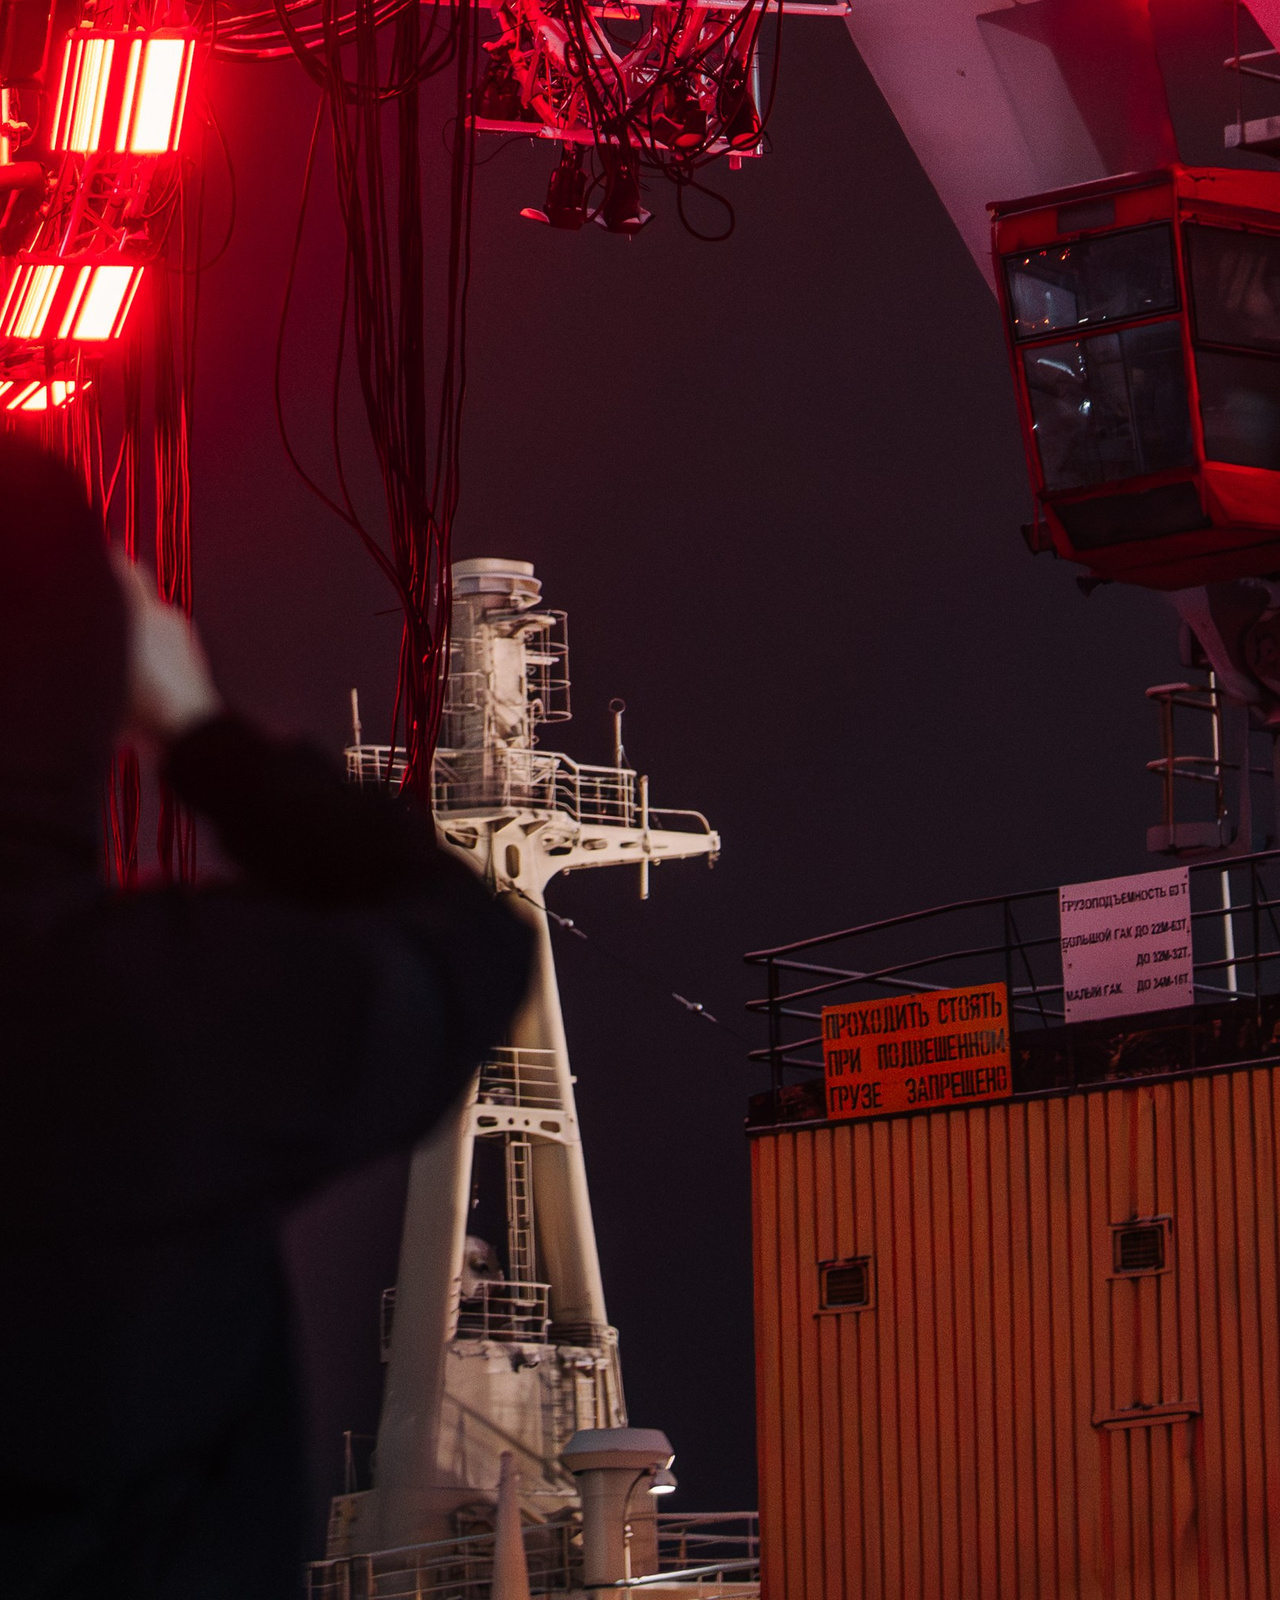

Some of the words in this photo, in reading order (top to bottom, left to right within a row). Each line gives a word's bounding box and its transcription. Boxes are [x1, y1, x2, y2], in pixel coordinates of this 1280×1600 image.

[1062, 888, 1166, 912] ГРУЗОПОДЪЕМНОСТЬ
[1061, 928, 1112, 949] БОЛЬШОЙ
[1114, 926, 1132, 939] ГАК
[1135, 923, 1149, 939] ДО
[1136, 953, 1150, 967] ДО
[1136, 978, 1151, 993] ДО
[825, 1002, 930, 1040] ПРОХОДИТЬ
[937, 992, 1002, 1024] СТОЯТЬ
[827, 1048, 862, 1078] ПРИ
[877, 1028, 1005, 1070] ПОДВЕШЕННОМ
[829, 1082, 883, 1112] ГРУЗЕ
[905, 1066, 1007, 1104] ЗАПРЕЩЕНО
